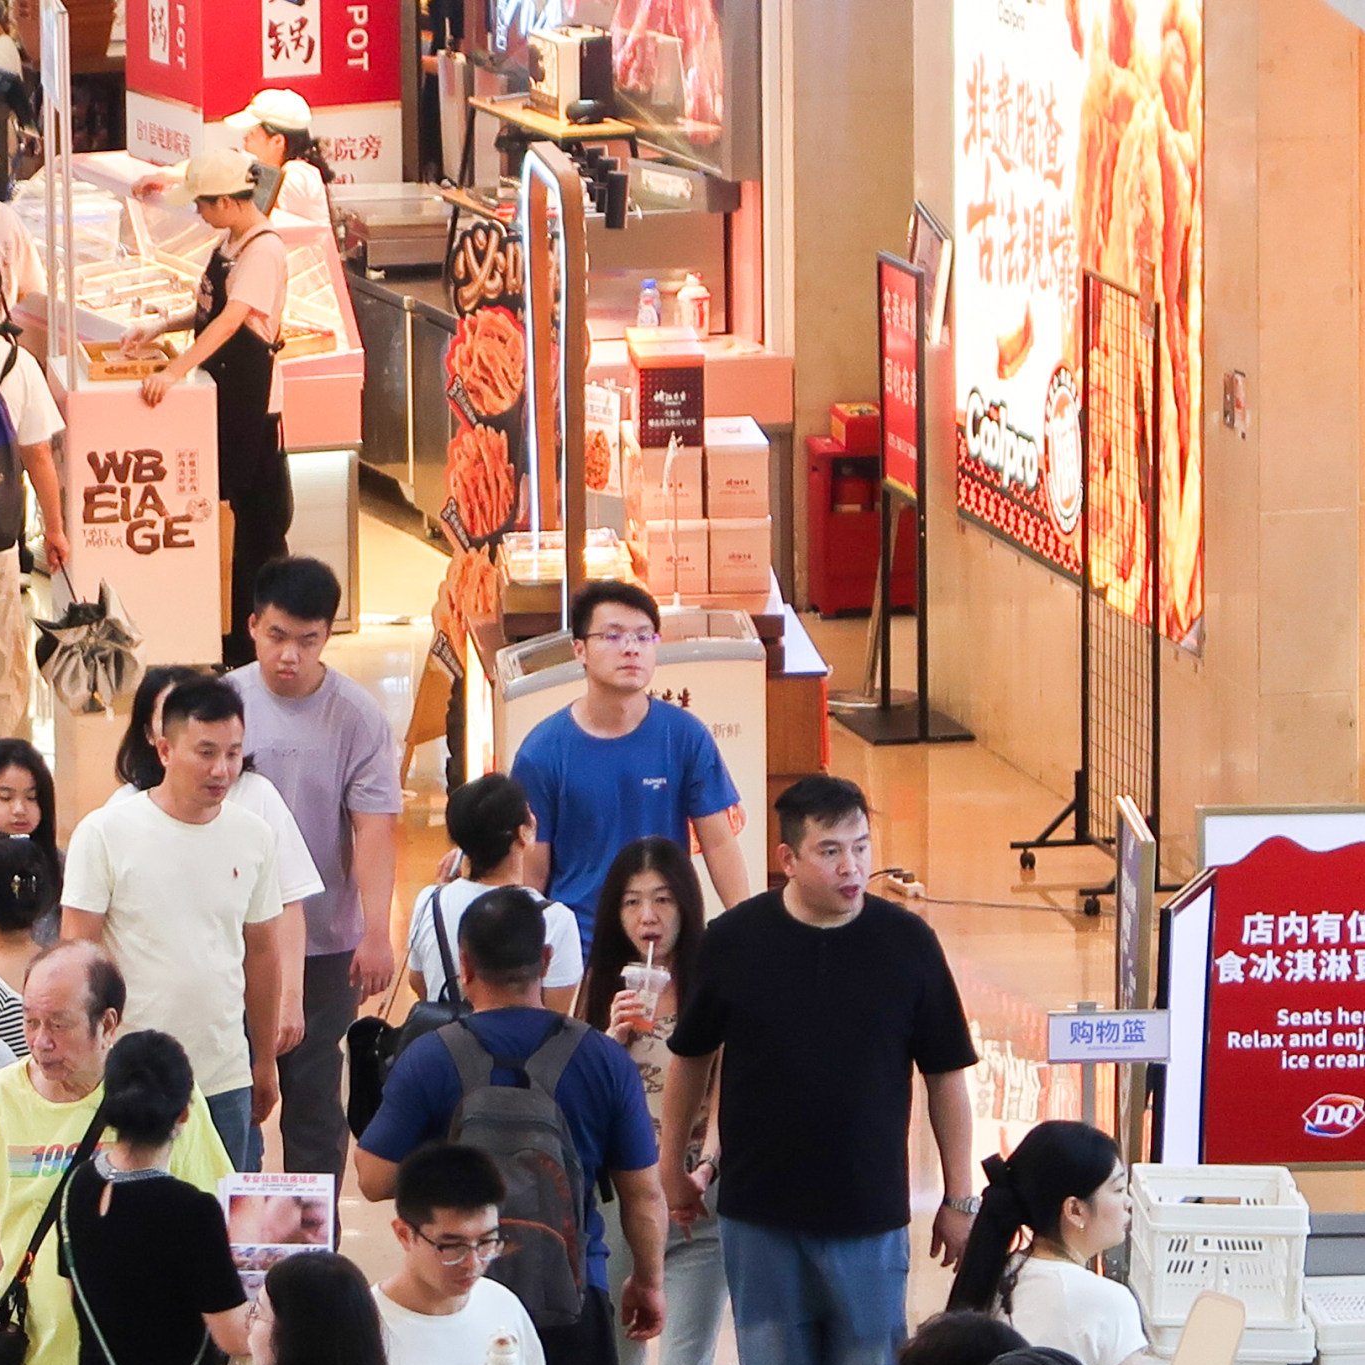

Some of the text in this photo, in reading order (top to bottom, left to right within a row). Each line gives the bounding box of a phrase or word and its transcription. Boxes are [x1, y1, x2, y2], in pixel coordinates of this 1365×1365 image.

[346, 4, 369, 72] POT
[87, 448, 168, 484] WB
[82, 484, 170, 524] EIA
[126, 513, 196, 555] GE
[1276, 1008, 1332, 1026] Seats
[1070, 1019, 1146, 1045] 购物篮
[1227, 1031, 1284, 1049] Relax
[1289, 1029, 1328, 1047] and
[1281, 1050, 1310, 1069] ice
[1314, 1103, 1357, 1128] DQ
